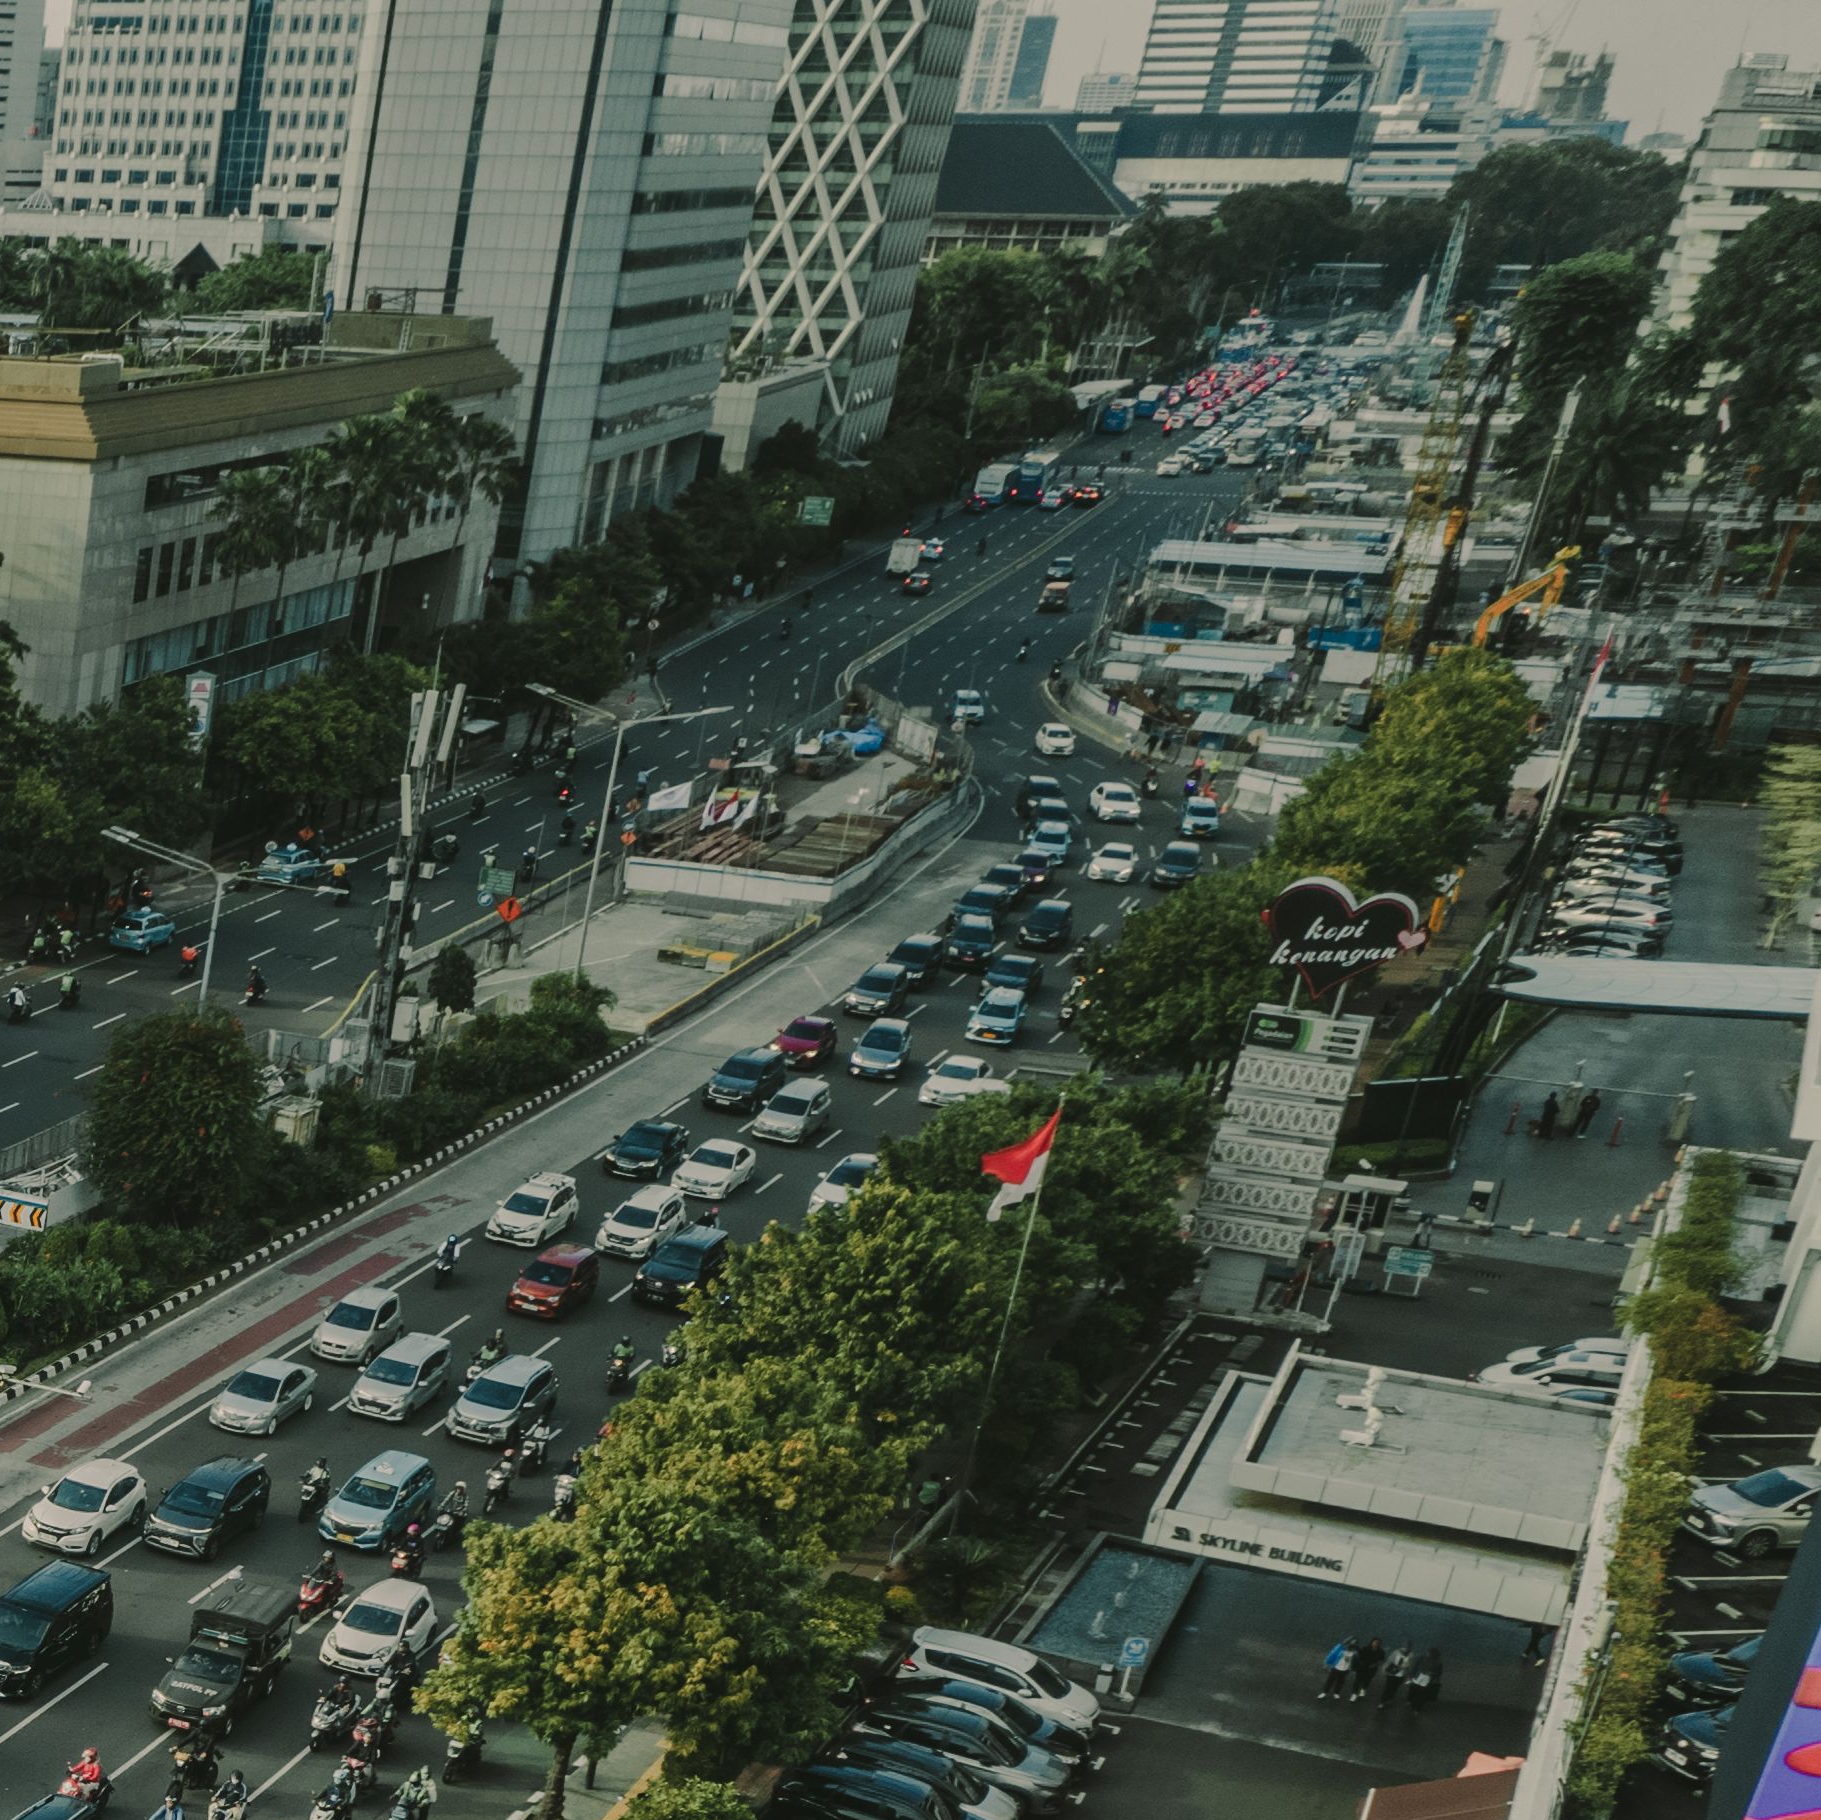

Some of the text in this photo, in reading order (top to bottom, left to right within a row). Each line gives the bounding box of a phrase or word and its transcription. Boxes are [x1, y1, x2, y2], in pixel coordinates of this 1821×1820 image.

[1304, 916, 1370, 942] kopi
[1268, 938, 1398, 967] kenangan
[1198, 1533, 1344, 1573] SKYLINE BUILDING
